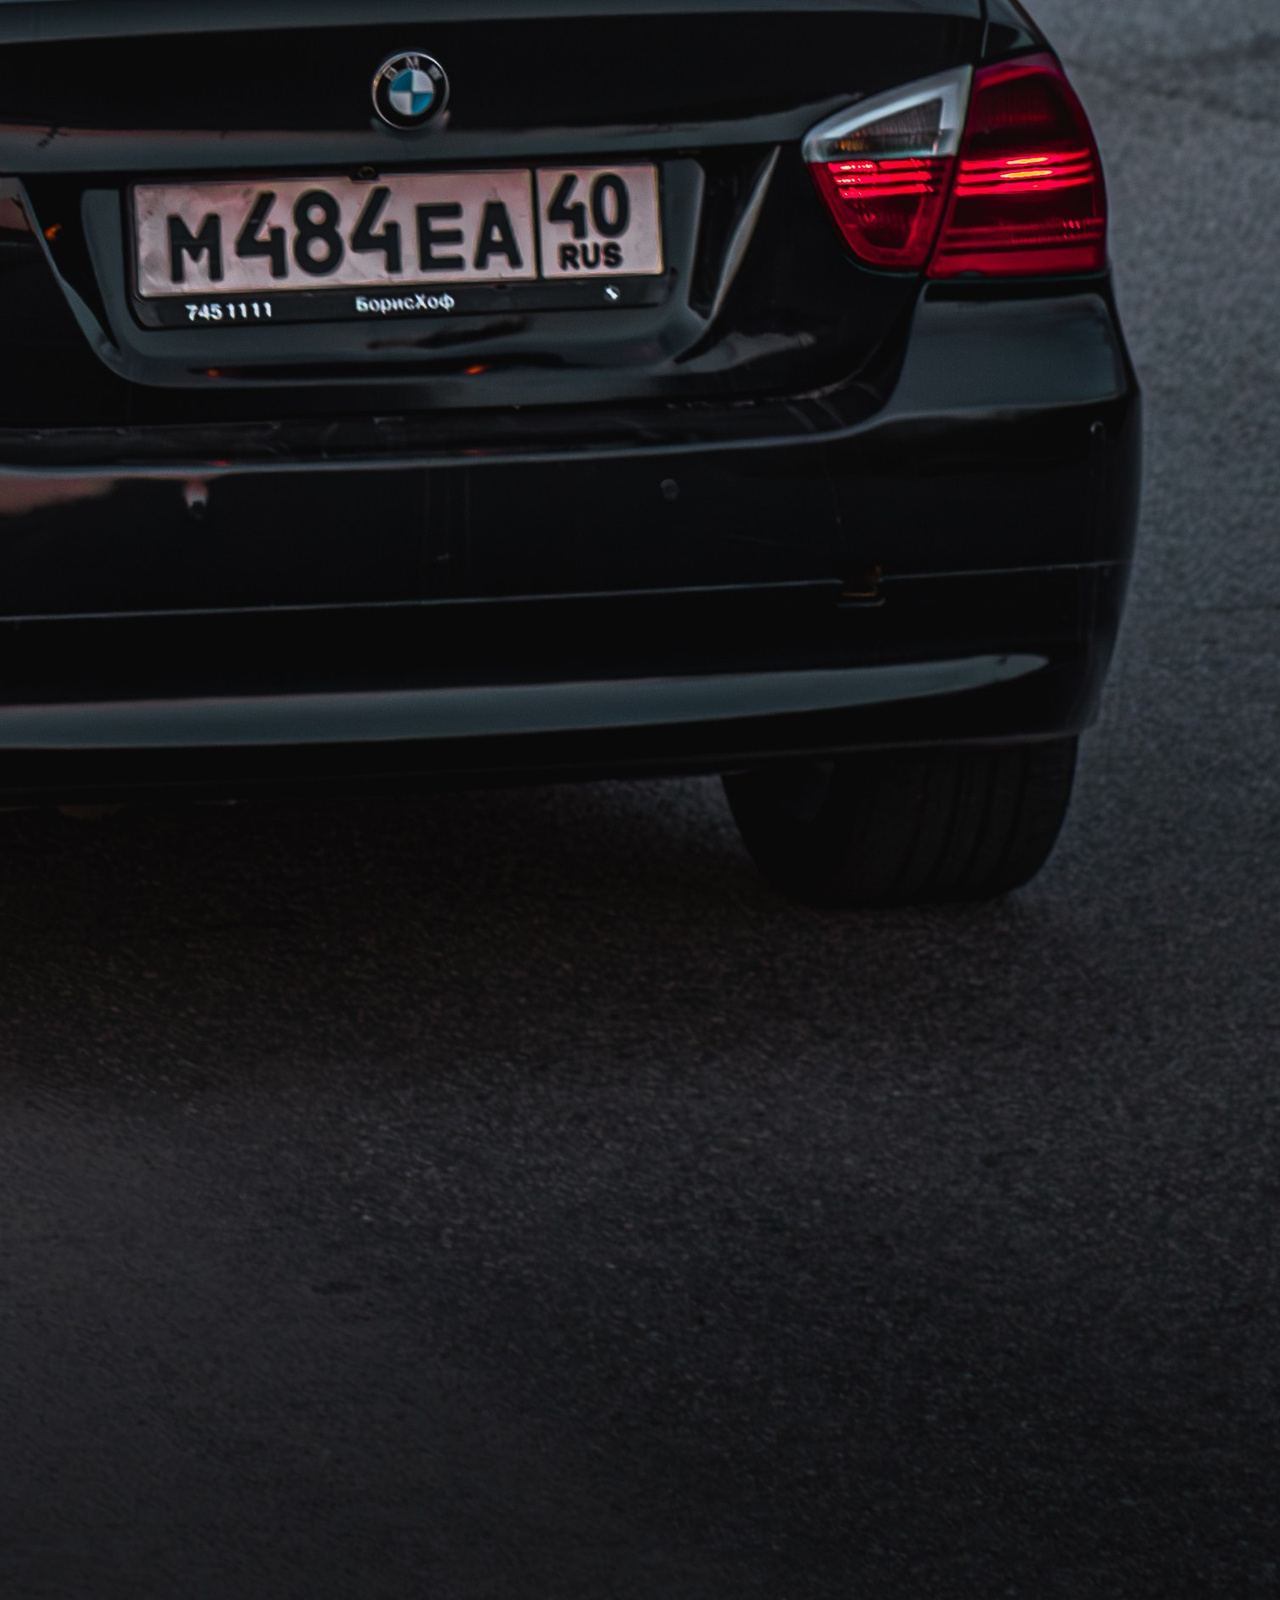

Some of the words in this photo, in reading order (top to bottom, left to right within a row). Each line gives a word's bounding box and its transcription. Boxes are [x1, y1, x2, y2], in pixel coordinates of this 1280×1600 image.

[167, 186, 523, 283] M484EA
[546, 172, 630, 240] 40
[558, 242, 623, 270] RUS
[355, 292, 455, 314] БорисХоф
